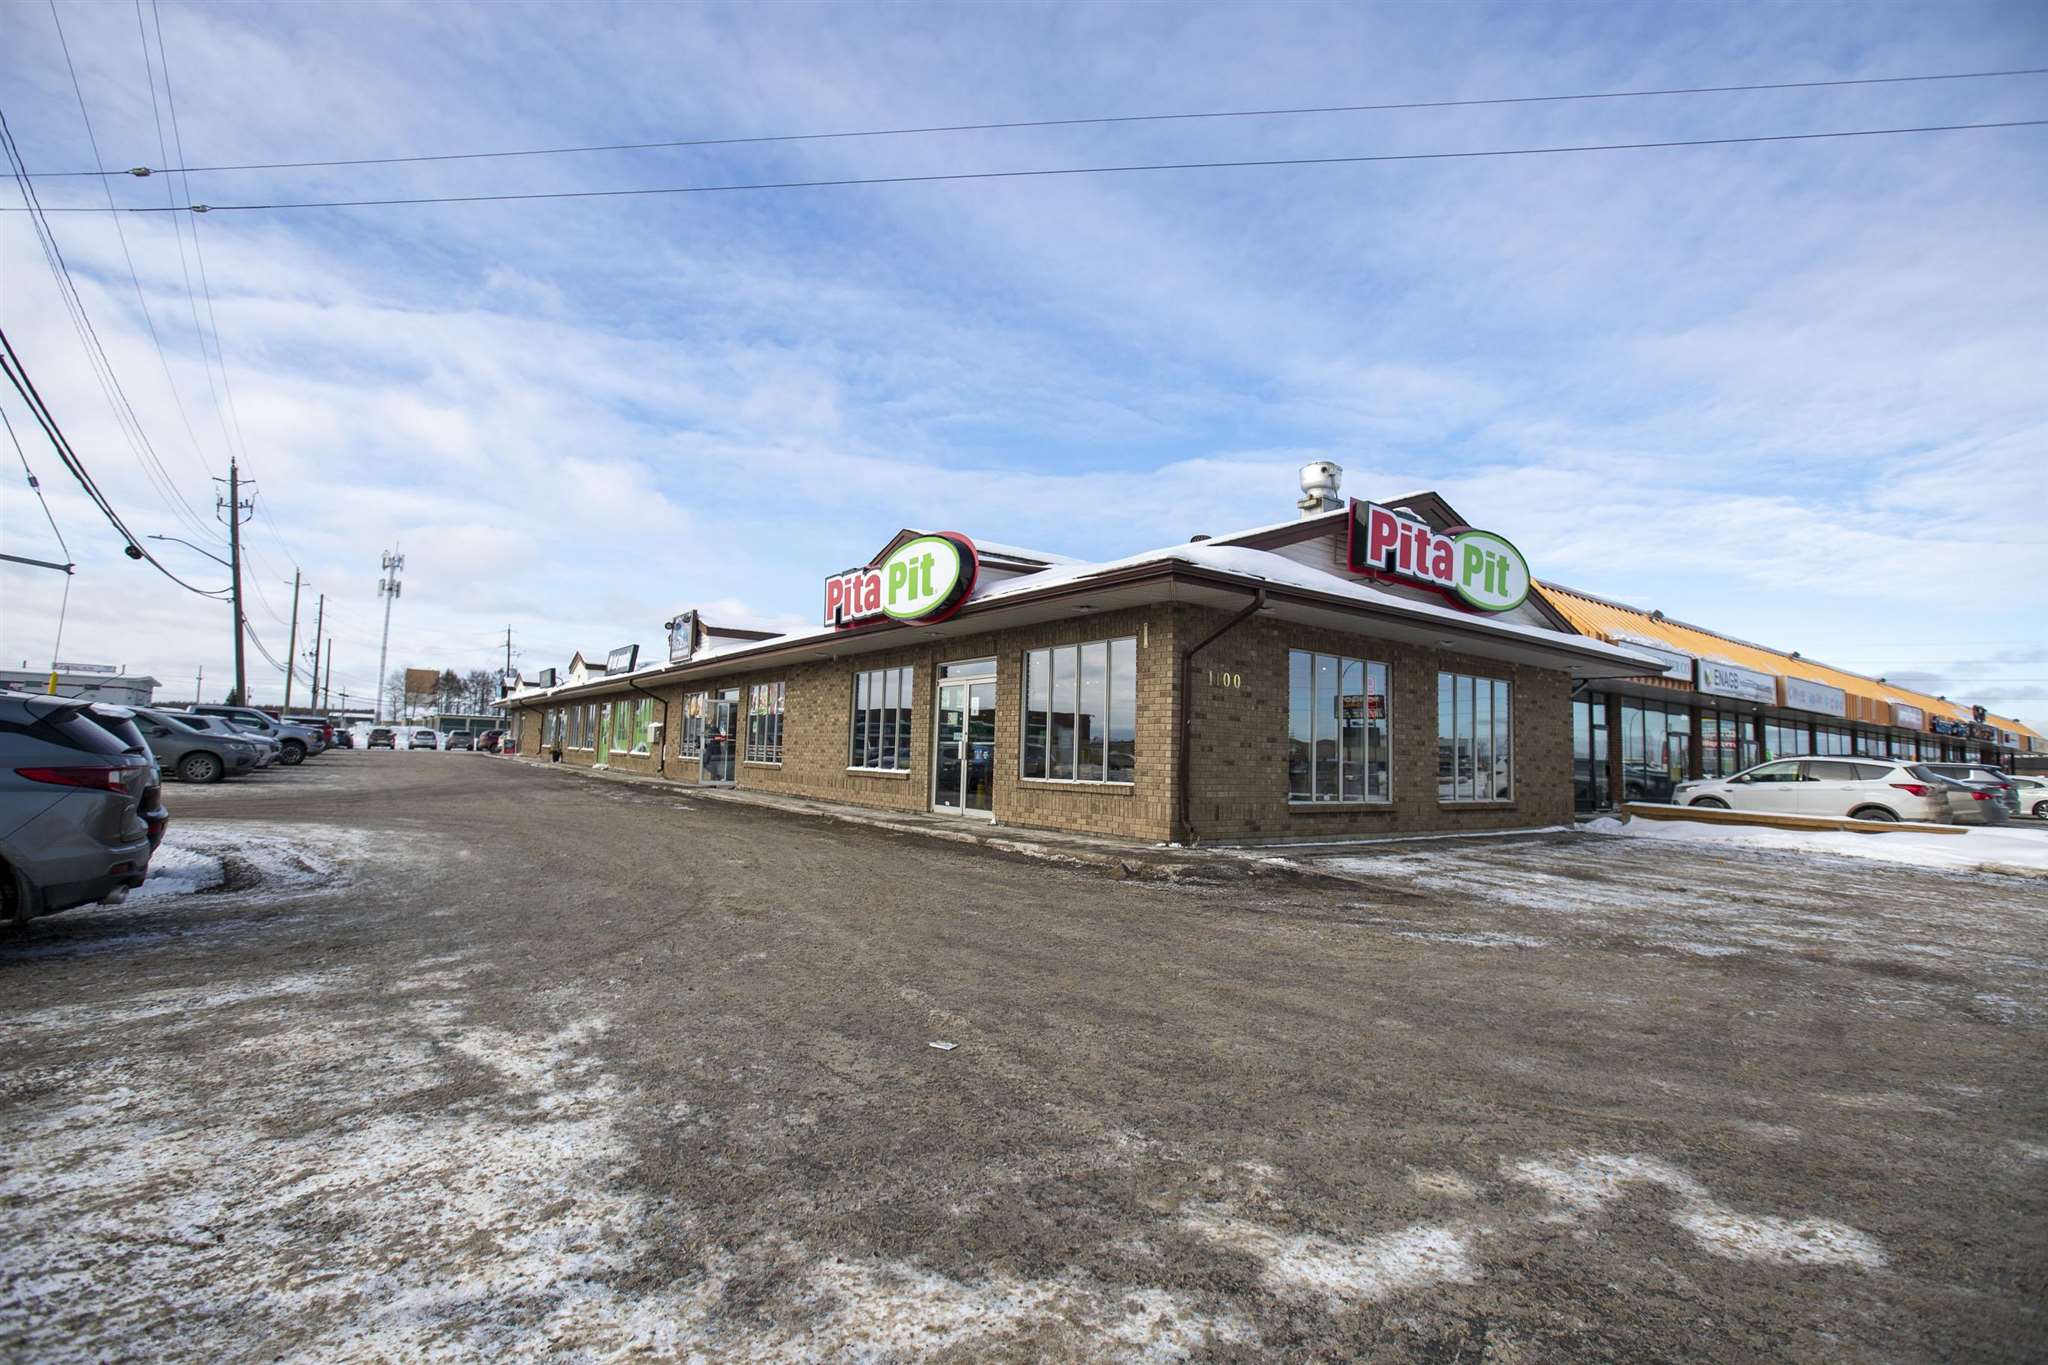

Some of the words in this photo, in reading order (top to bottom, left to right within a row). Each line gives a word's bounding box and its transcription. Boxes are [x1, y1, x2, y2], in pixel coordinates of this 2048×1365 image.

[827, 574, 881, 620] Pita
[888, 552, 935, 606] Pit
[1370, 509, 1454, 582] Pita
[1463, 543, 1511, 597] Pit
